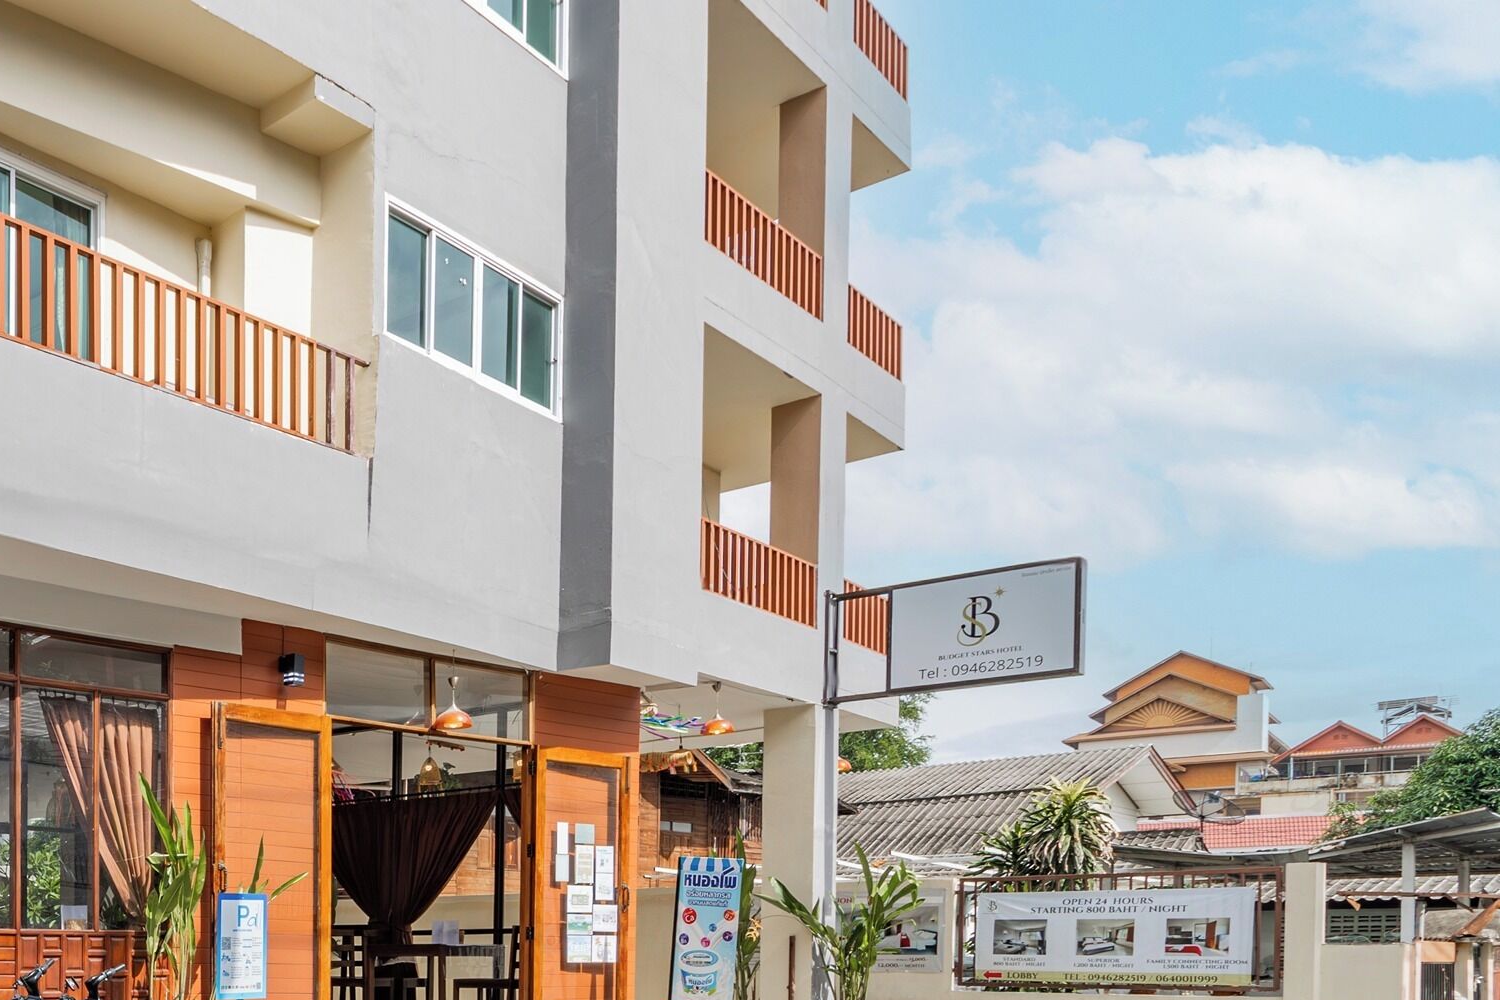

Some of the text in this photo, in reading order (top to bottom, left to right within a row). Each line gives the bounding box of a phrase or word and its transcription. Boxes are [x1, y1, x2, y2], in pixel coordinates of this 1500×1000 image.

[938, 652, 969, 661] BUDGET
[996, 645, 1023, 653] HOTEL
[919, 667, 939, 679] Tel
[951, 655, 1044, 676] 0946282519
[684, 867, 737, 888] หนองโพ
[1113, 897, 1154, 905] HOURS
[1149, 905, 1188, 913] NIGHT
[1155, 975, 1218, 983] 0640011999
